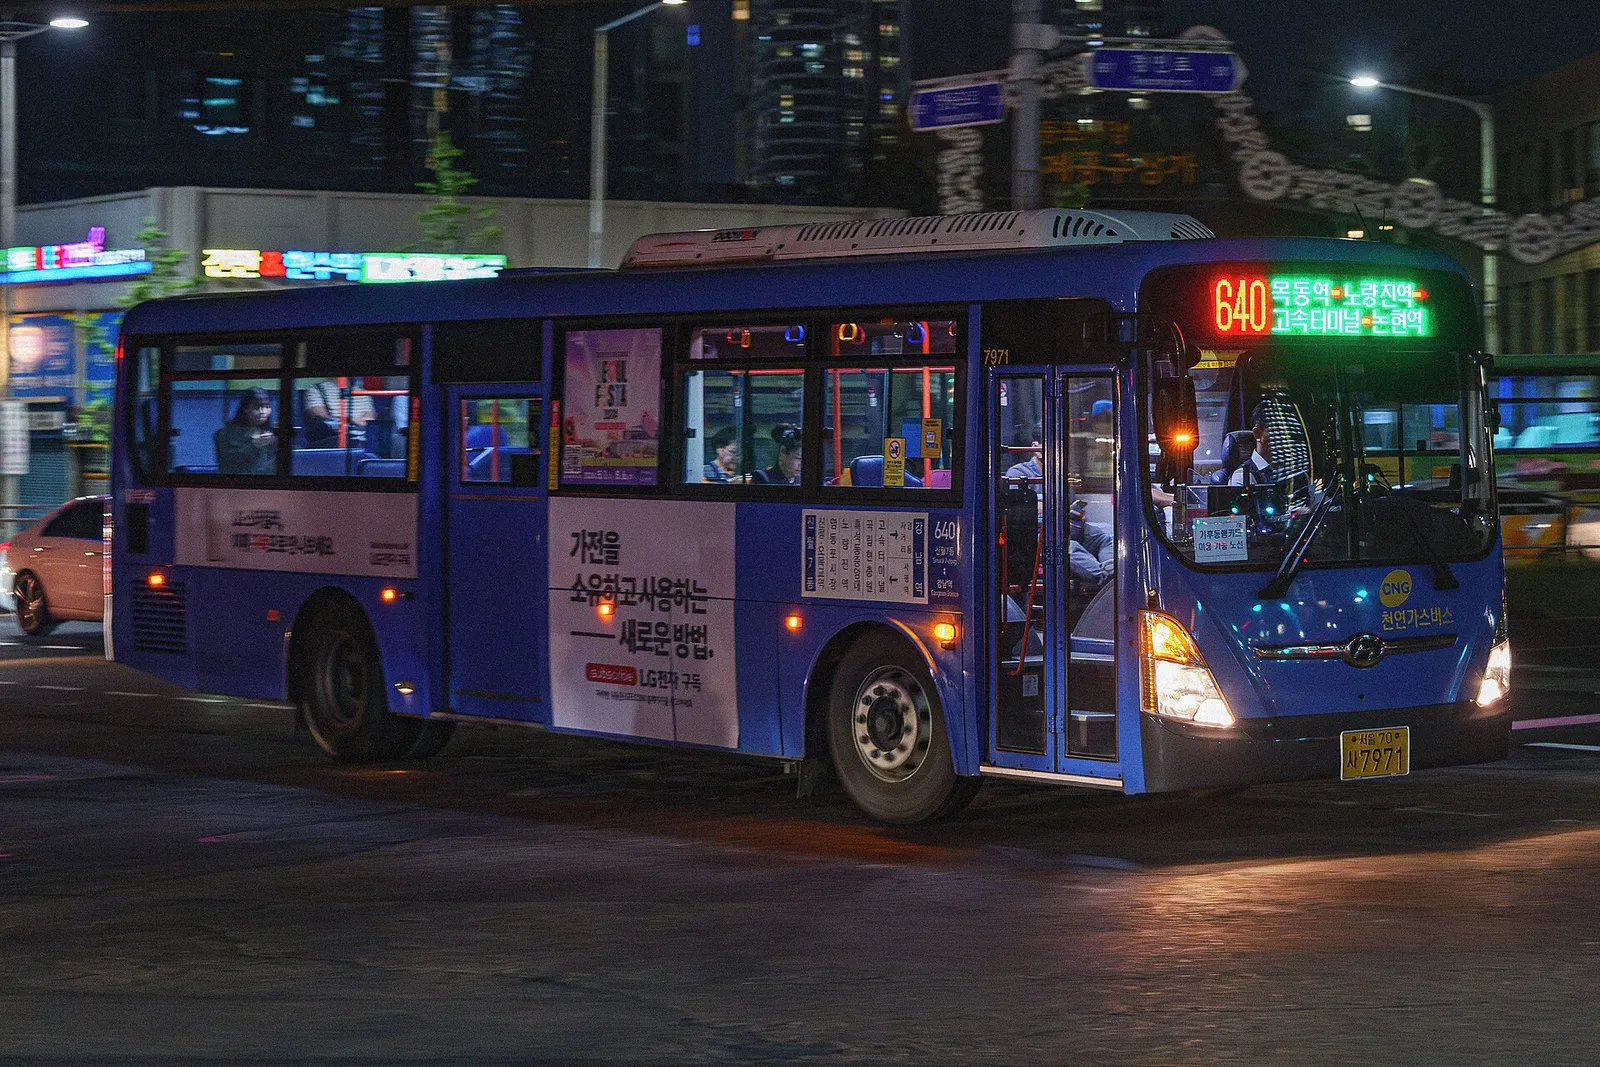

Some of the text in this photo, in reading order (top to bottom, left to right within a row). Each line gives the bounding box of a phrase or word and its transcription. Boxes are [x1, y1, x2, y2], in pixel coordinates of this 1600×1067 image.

[1215, 279, 1267, 332] 640
[1271, 281, 1413, 308] 목동역 노량진역
[1271, 309, 1423, 335] 고속터미널 논현역
[983, 348, 1009, 365] 7971
[934, 521, 956, 540] 640
[569, 529, 621, 566] 가전을
[1229, 541, 1244, 550] 노선
[640, 576, 709, 615] 사용하는
[1381, 581, 1410, 596] CNG
[1381, 606, 1454, 631] 천연가스버스
[619, 619, 671, 657] 새로운
[639, 668, 702, 692] LG전자 구독
